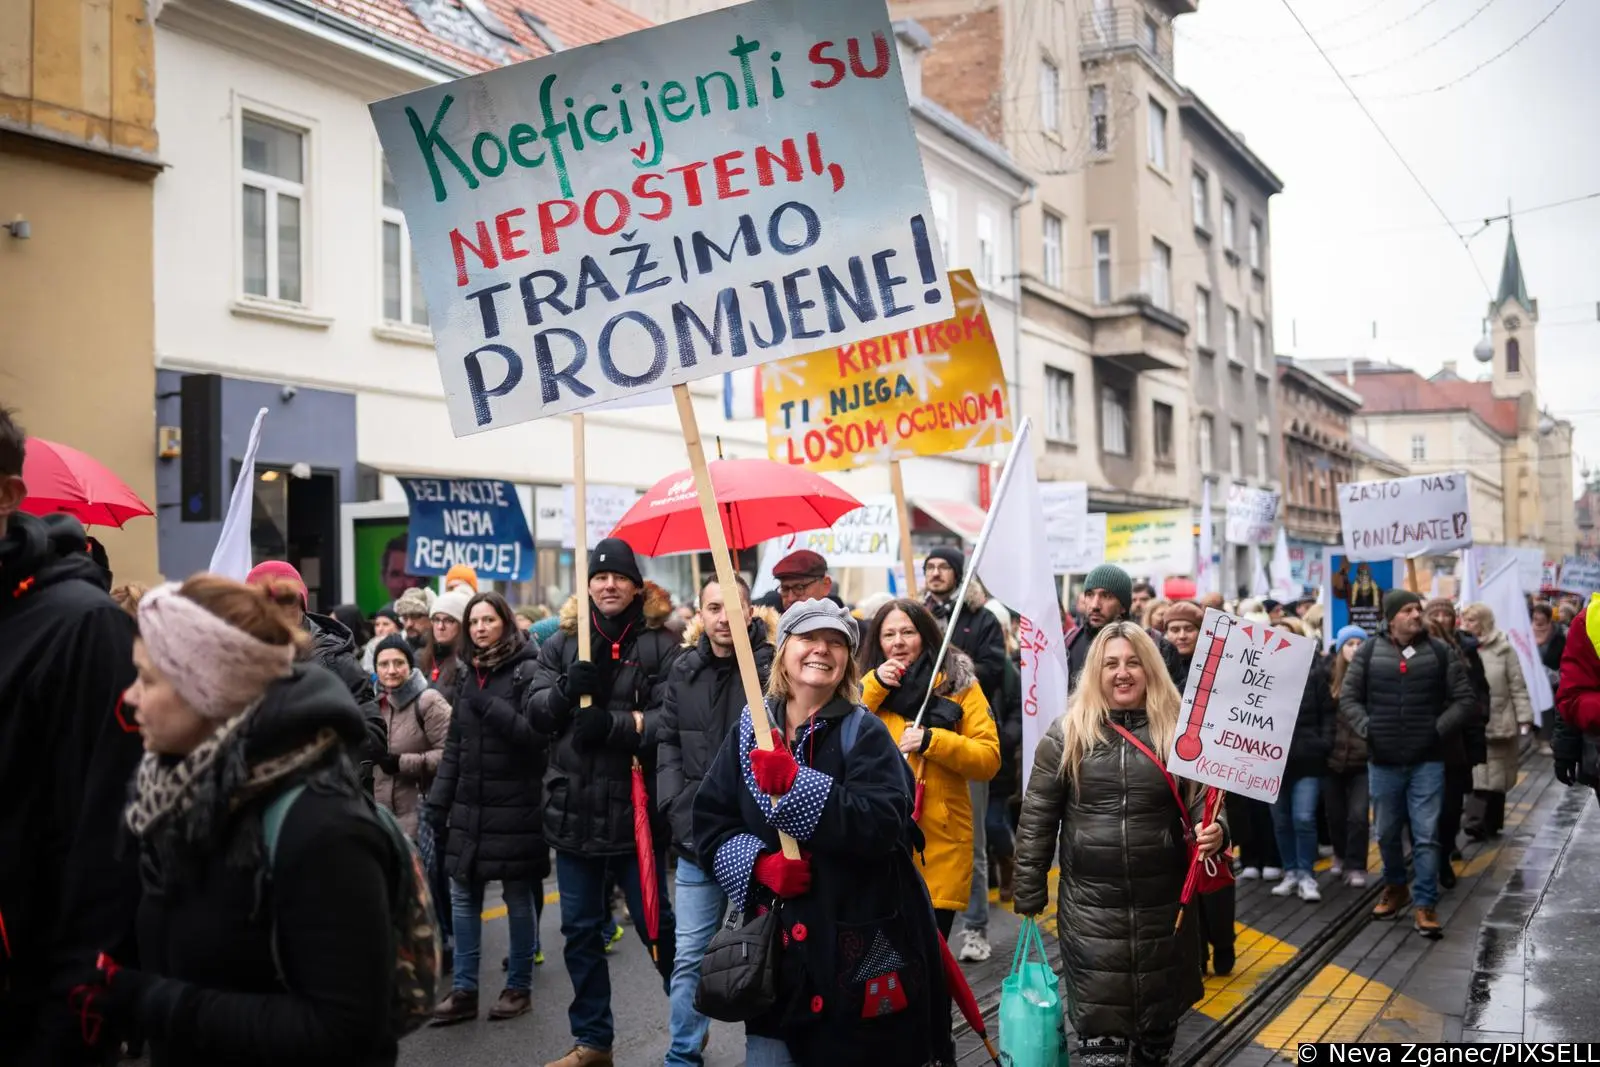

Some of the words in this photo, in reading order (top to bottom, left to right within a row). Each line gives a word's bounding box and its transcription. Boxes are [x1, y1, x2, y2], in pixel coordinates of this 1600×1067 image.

[405, 35, 785, 202] Koeficijenti
[808, 30, 890, 89] SU
[449, 132, 845, 287] NEPOŠTENI,
[465, 201, 821, 338] TRAŽIMO
[464, 214, 942, 426] PROMJENE!
[781, 400, 809, 429] TI
[830, 374, 914, 415] NJEGA
[788, 417, 888, 464] LOŠOM
[896, 389, 1003, 439] OCJENOM
[409, 481, 445, 501] BEZ
[449, 481, 509, 507] AKCIJE
[443, 509, 494, 536] NEMA
[413, 536, 521, 580] REAKCIJE!
[1239, 648, 1263, 667] NE
[1242, 669, 1275, 690] DIŽE
[1228, 706, 1274, 731] SVIMA
[1244, 693, 1267, 709] SE
[1214, 730, 1283, 760] JEDNAKO
